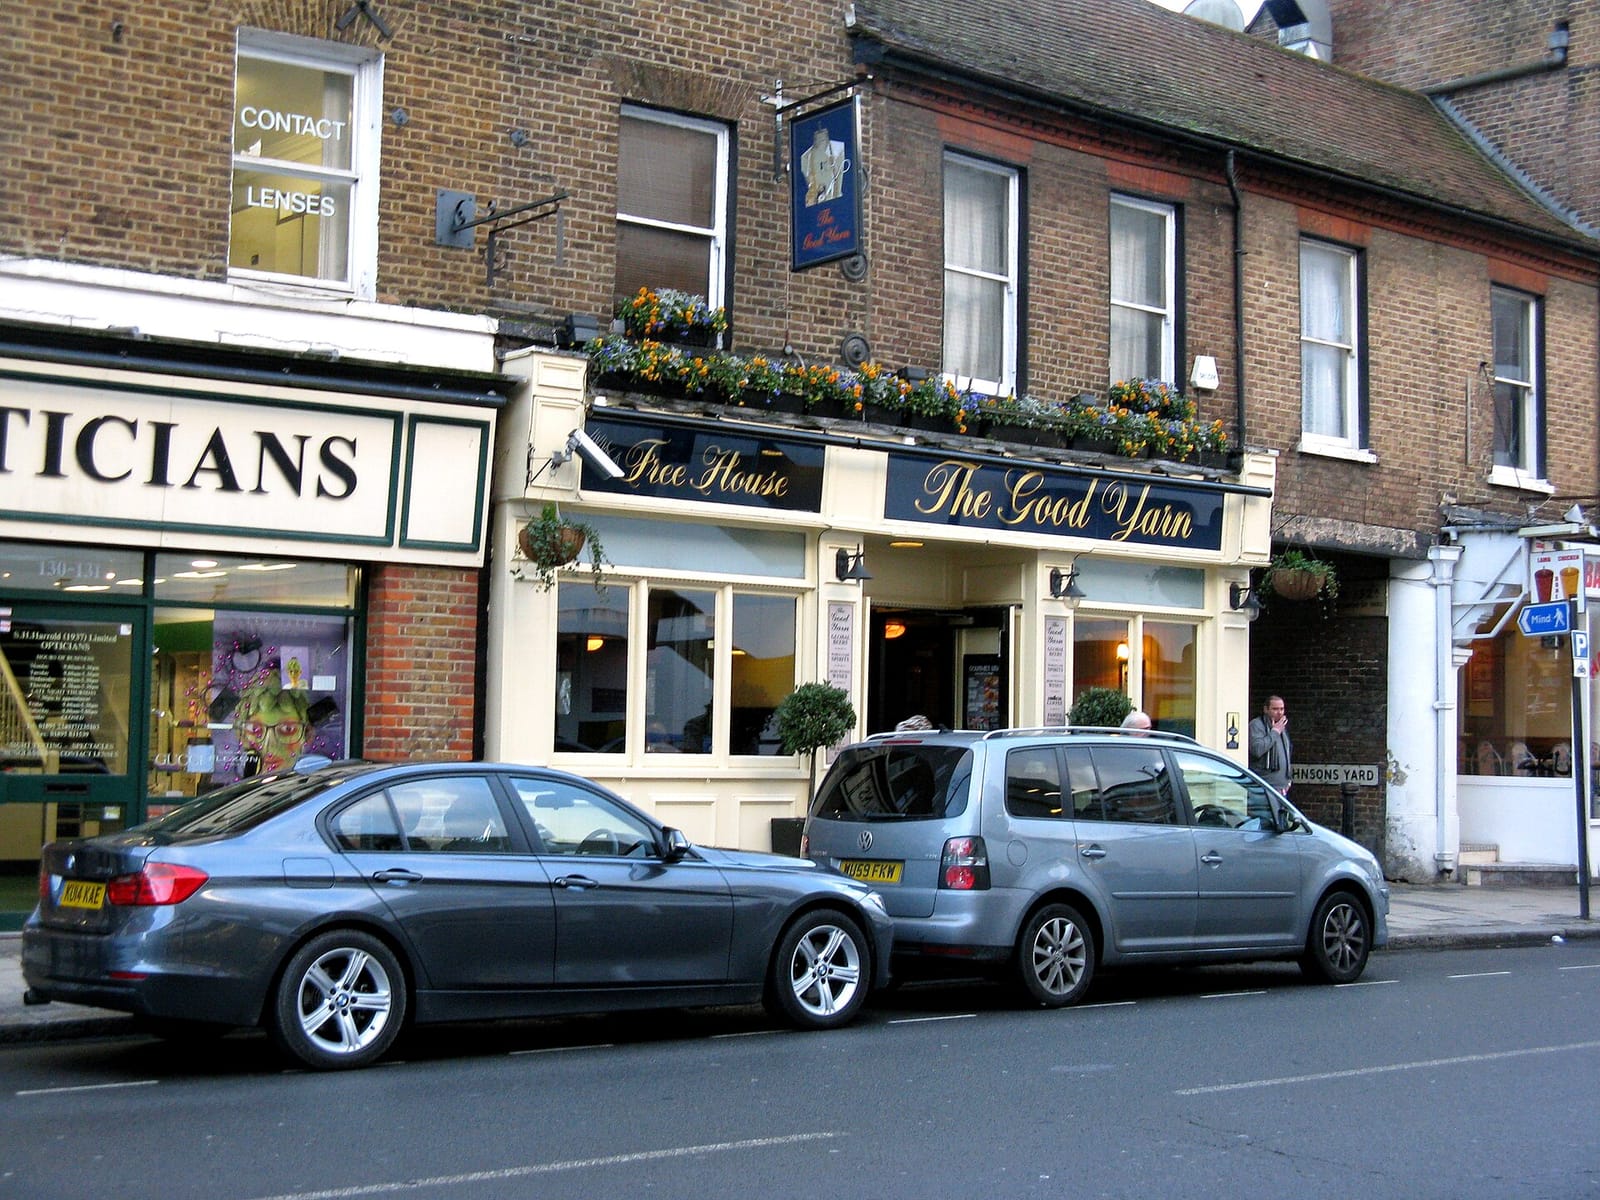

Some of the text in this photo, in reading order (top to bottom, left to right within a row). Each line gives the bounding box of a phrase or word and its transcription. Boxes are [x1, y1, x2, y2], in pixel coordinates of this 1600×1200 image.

[240, 106, 346, 141] CONTACT
[247, 186, 335, 217] LENSES
[817, 208, 834, 227] The
[802, 227, 851, 251] Good Yarn
[0, 405, 358, 501] TICIANS
[620, 437, 790, 498] Free House
[914, 459, 1195, 542] The Good Yarn
[38, 560, 101, 578] 130-131
[1531, 613, 1552, 625] Mind
[40, 641, 90, 652] OPTICIANS
[88, 633, 118, 643] Limited
[1576, 634, 1587, 656] P
[1292, 768, 1374, 781] HNSONS YARD
[83, 886, 102, 904] KAE
